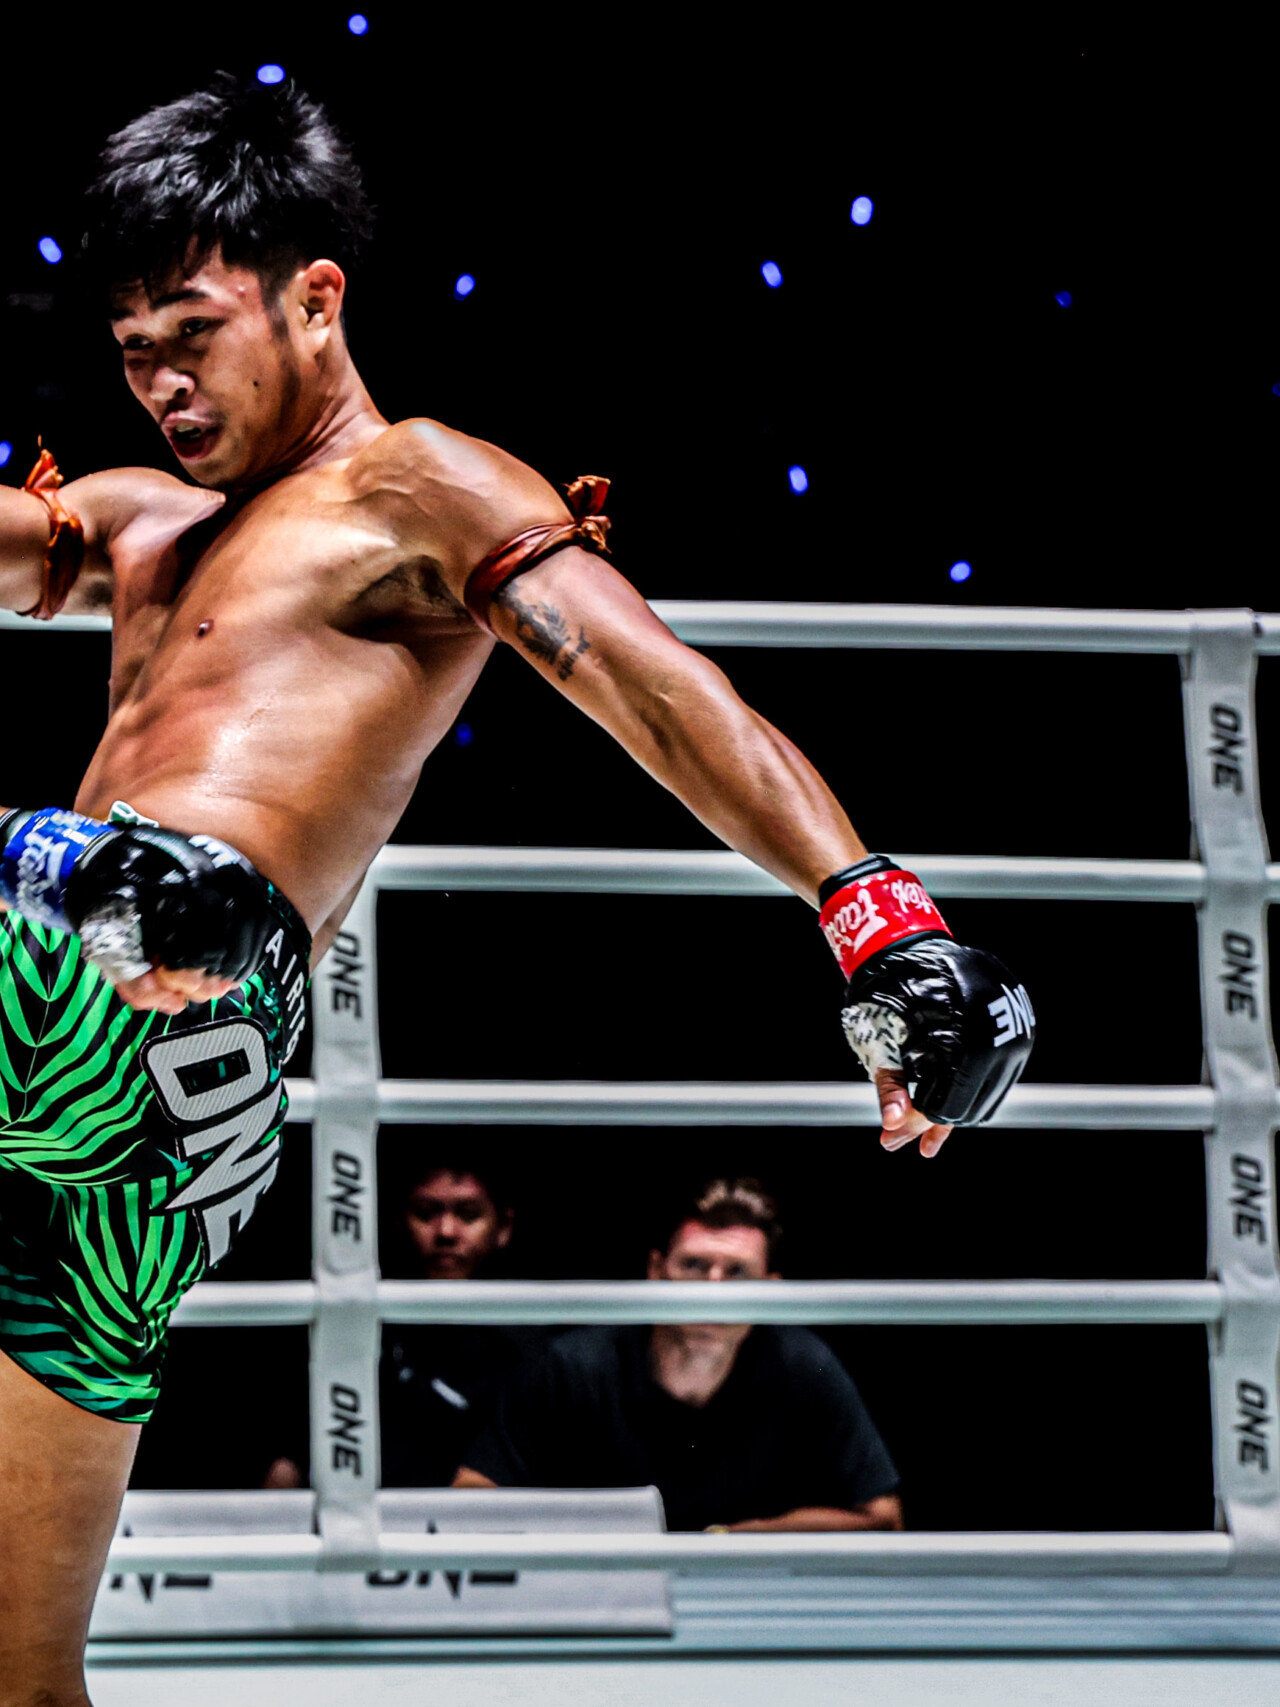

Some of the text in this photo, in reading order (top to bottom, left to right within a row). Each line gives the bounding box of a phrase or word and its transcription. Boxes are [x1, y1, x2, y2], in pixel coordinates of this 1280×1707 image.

[1207, 702, 1246, 797] ONE
[327, 928, 366, 1021] ONE
[1218, 930, 1260, 1023] ONE
[142, 1018, 284, 1268] ONE
[326, 1149, 365, 1245] ONE
[1228, 1151, 1268, 1247] ONE
[325, 1381, 364, 1479] ONE
[1233, 1378, 1273, 1474] ONE
